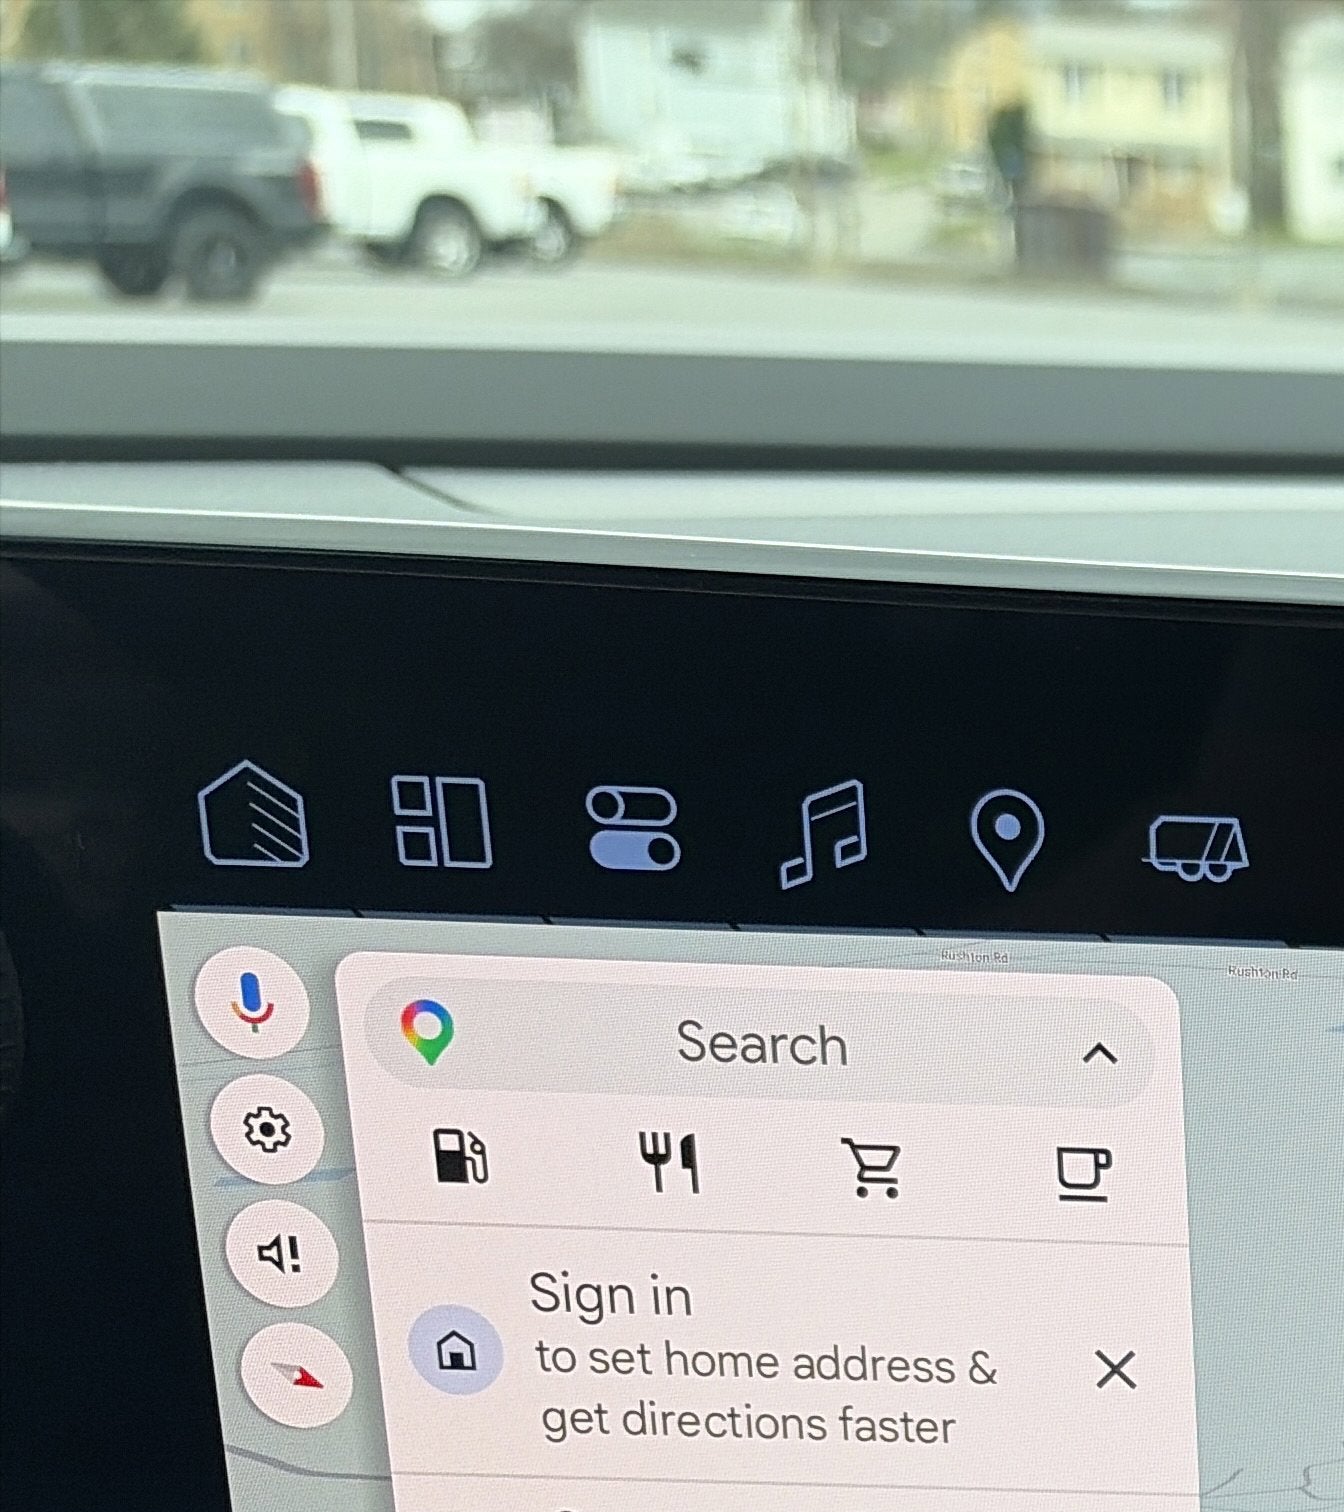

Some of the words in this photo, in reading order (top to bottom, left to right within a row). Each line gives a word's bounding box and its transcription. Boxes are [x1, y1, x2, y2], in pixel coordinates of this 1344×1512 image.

[677, 1018, 848, 1066] Search
[530, 1271, 637, 1324] Sign
[648, 1273, 693, 1318] in
[535, 1339, 578, 1375] to
[588, 1342, 653, 1377] set
[665, 1341, 780, 1380] home
[793, 1344, 955, 1386] address
[967, 1351, 998, 1385] &
[541, 1406, 610, 1445] get
[622, 1401, 827, 1443] directions
[838, 1404, 956, 1446] faster
